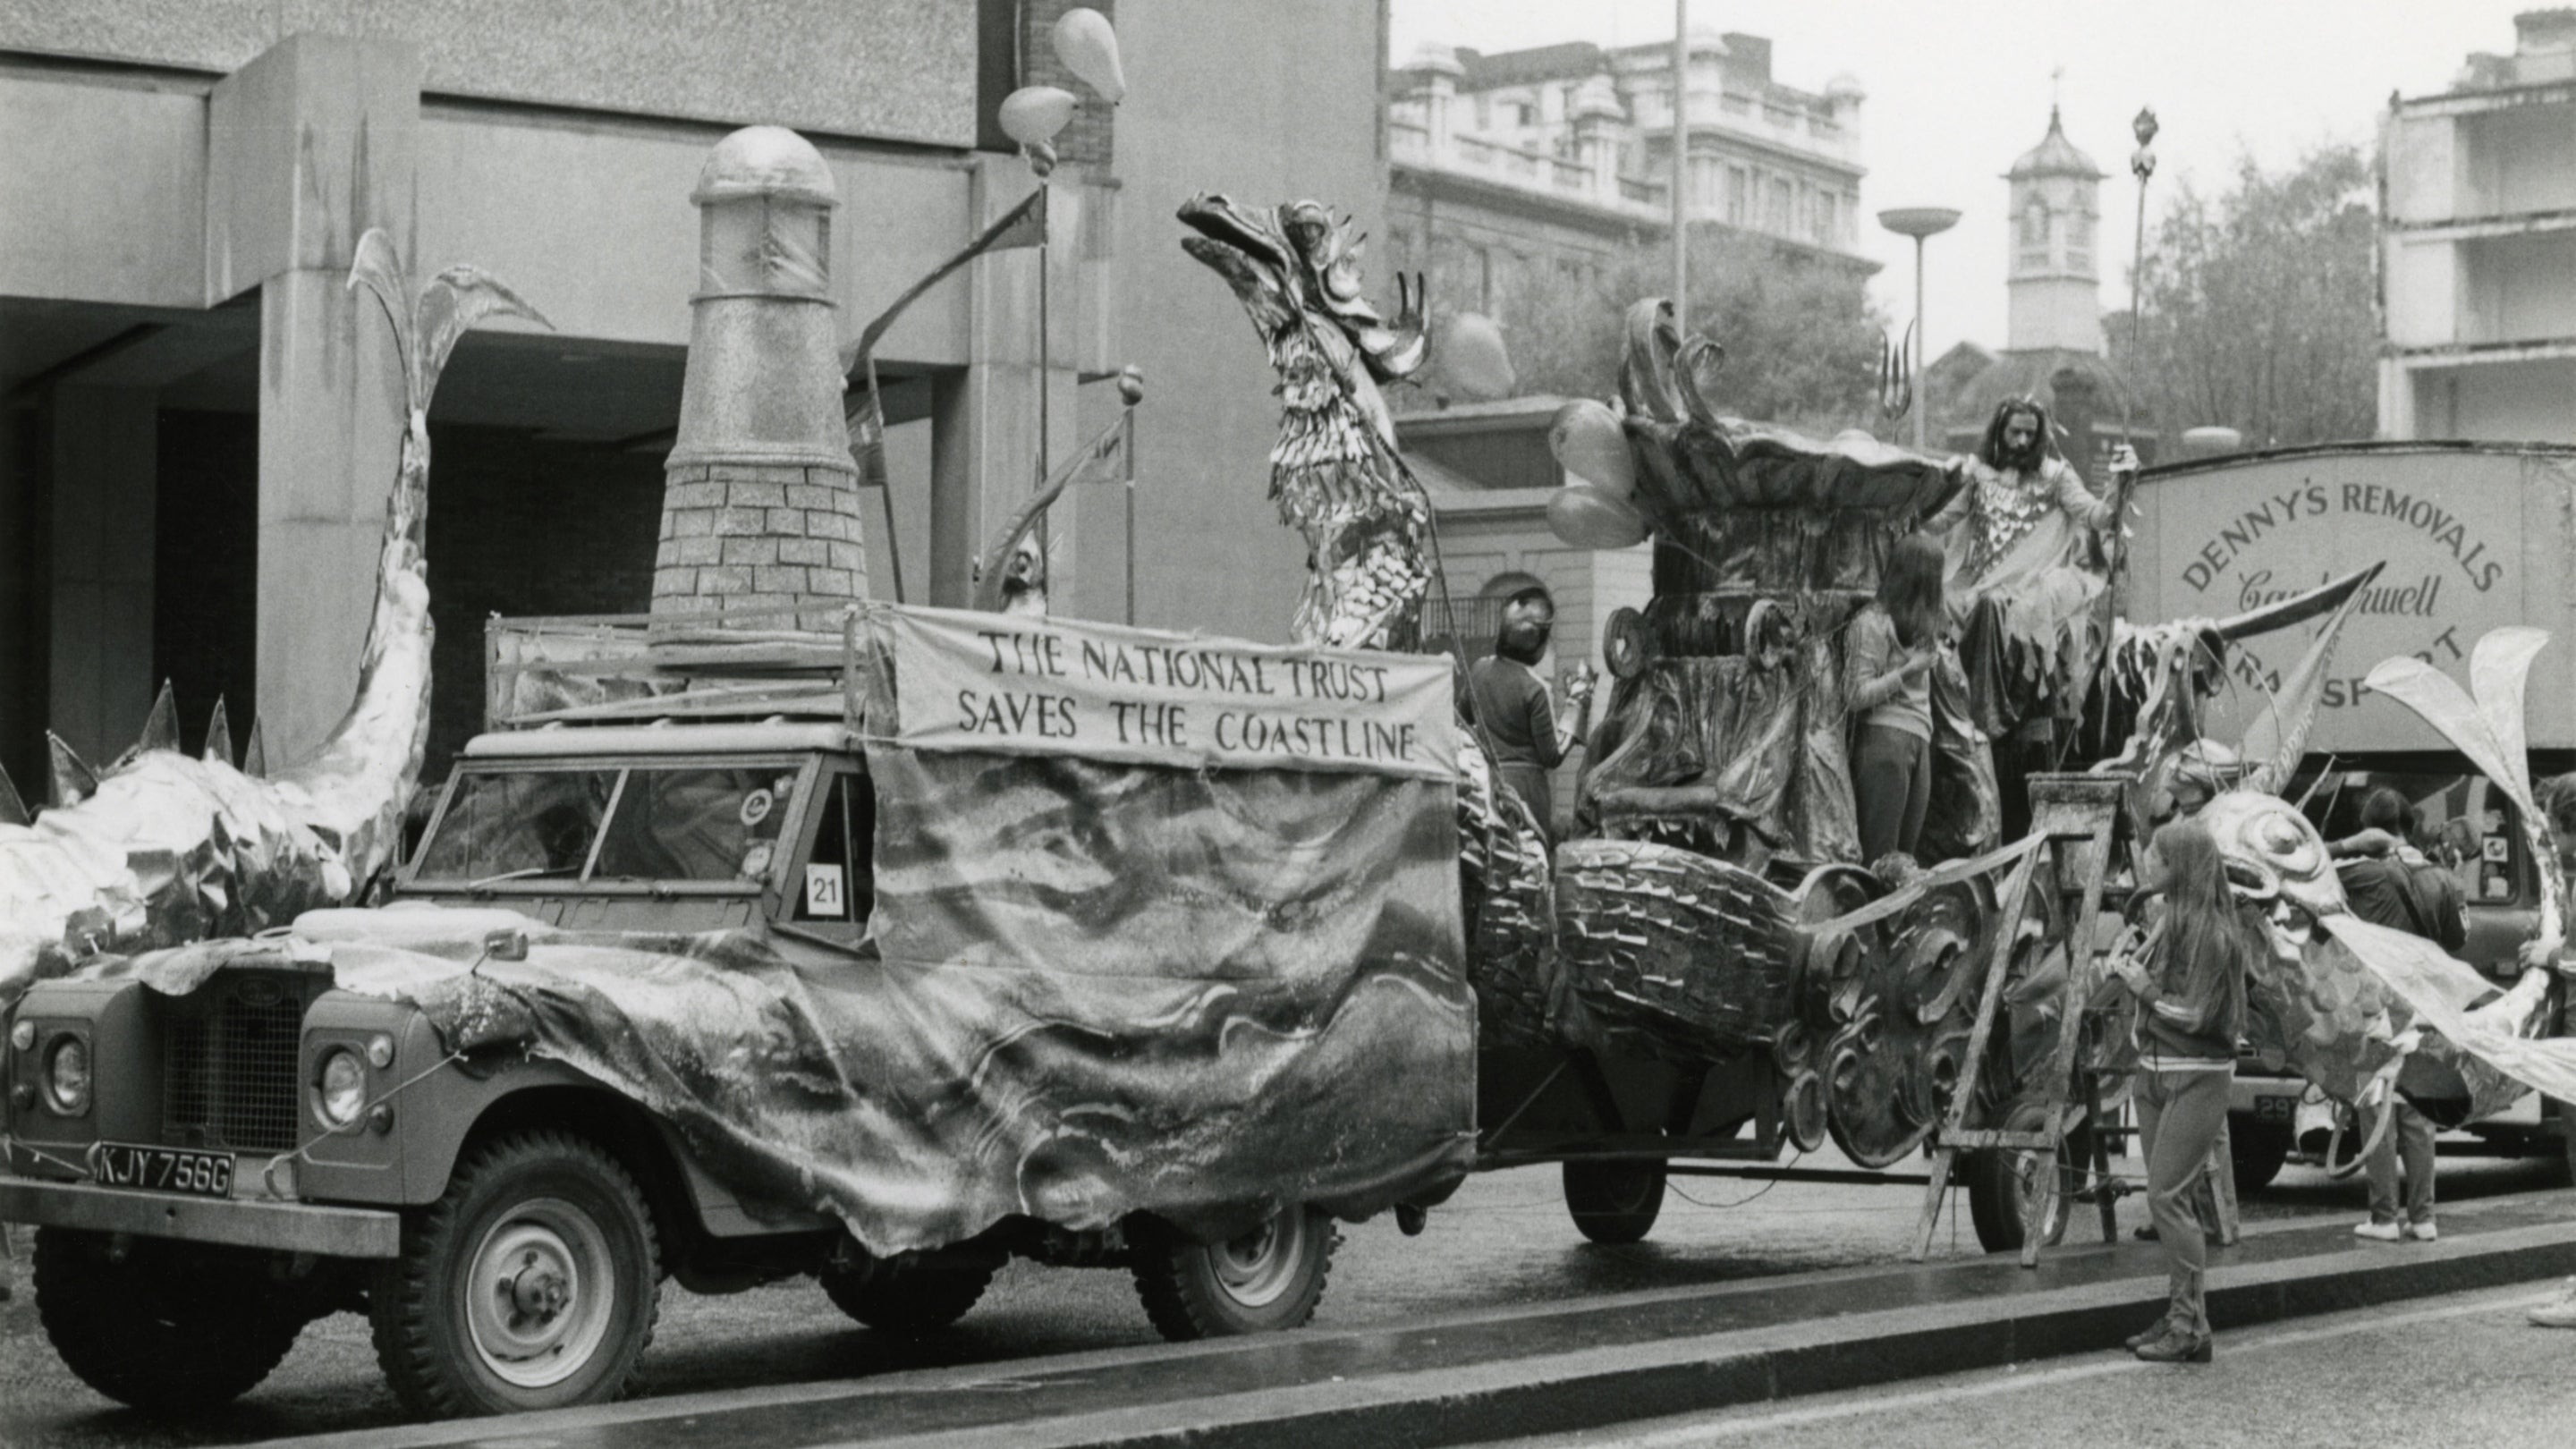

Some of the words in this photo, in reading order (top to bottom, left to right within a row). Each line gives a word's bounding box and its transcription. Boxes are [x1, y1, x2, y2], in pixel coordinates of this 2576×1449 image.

[2182, 477, 2328, 592] DENNY'S
[2343, 483, 2503, 593] REMOVALS
[978, 631, 1066, 676] THE
[1081, 640, 1275, 696] NATIONAL
[1282, 657, 1388, 704] TRUST
[958, 690, 1078, 738] SAVES
[1109, 700, 1188, 747] THE
[1215, 712, 1415, 762] COASTLINE
[813, 877, 837, 903] 21
[99, 1148, 151, 1186] KJY
[157, 1152, 230, 1193] 756G
